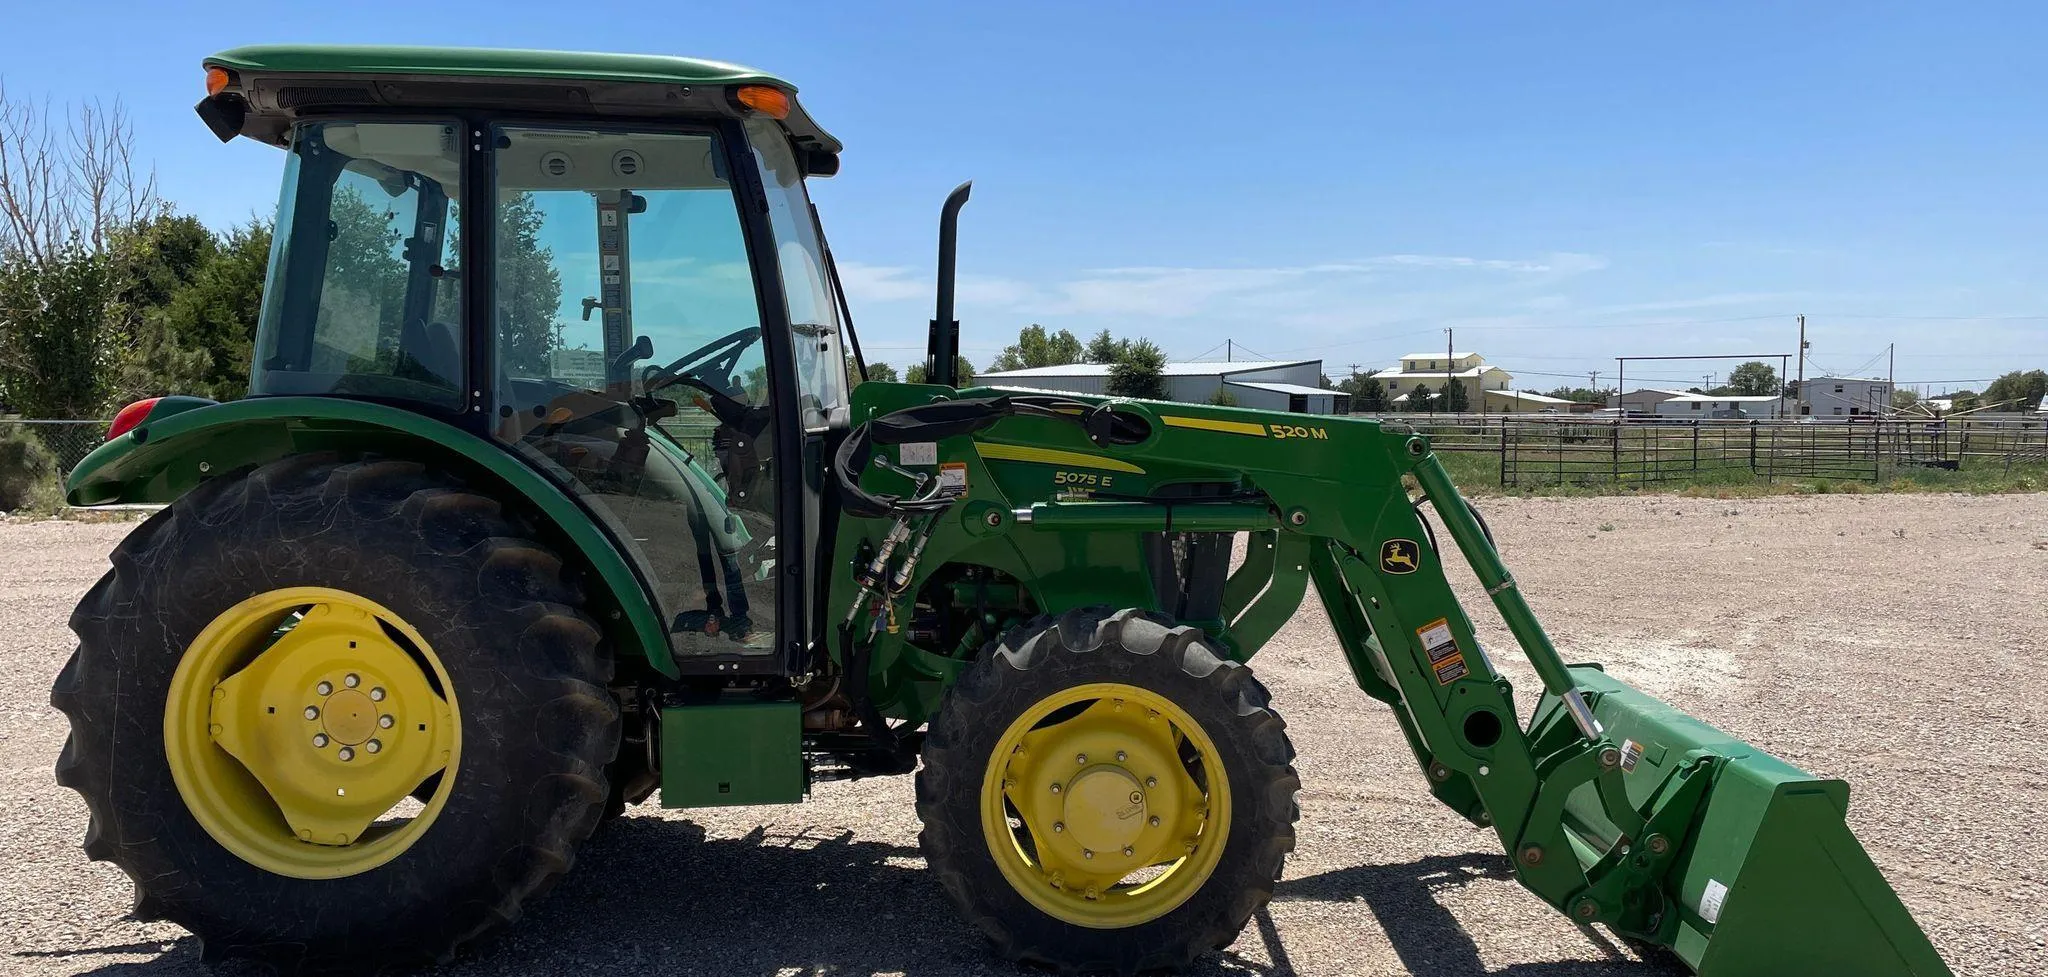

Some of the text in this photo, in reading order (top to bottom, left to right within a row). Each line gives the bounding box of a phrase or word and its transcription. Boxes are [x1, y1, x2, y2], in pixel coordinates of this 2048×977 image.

[1269, 424, 1329, 440] 520 M
[1054, 471, 1113, 487] 5075 E
